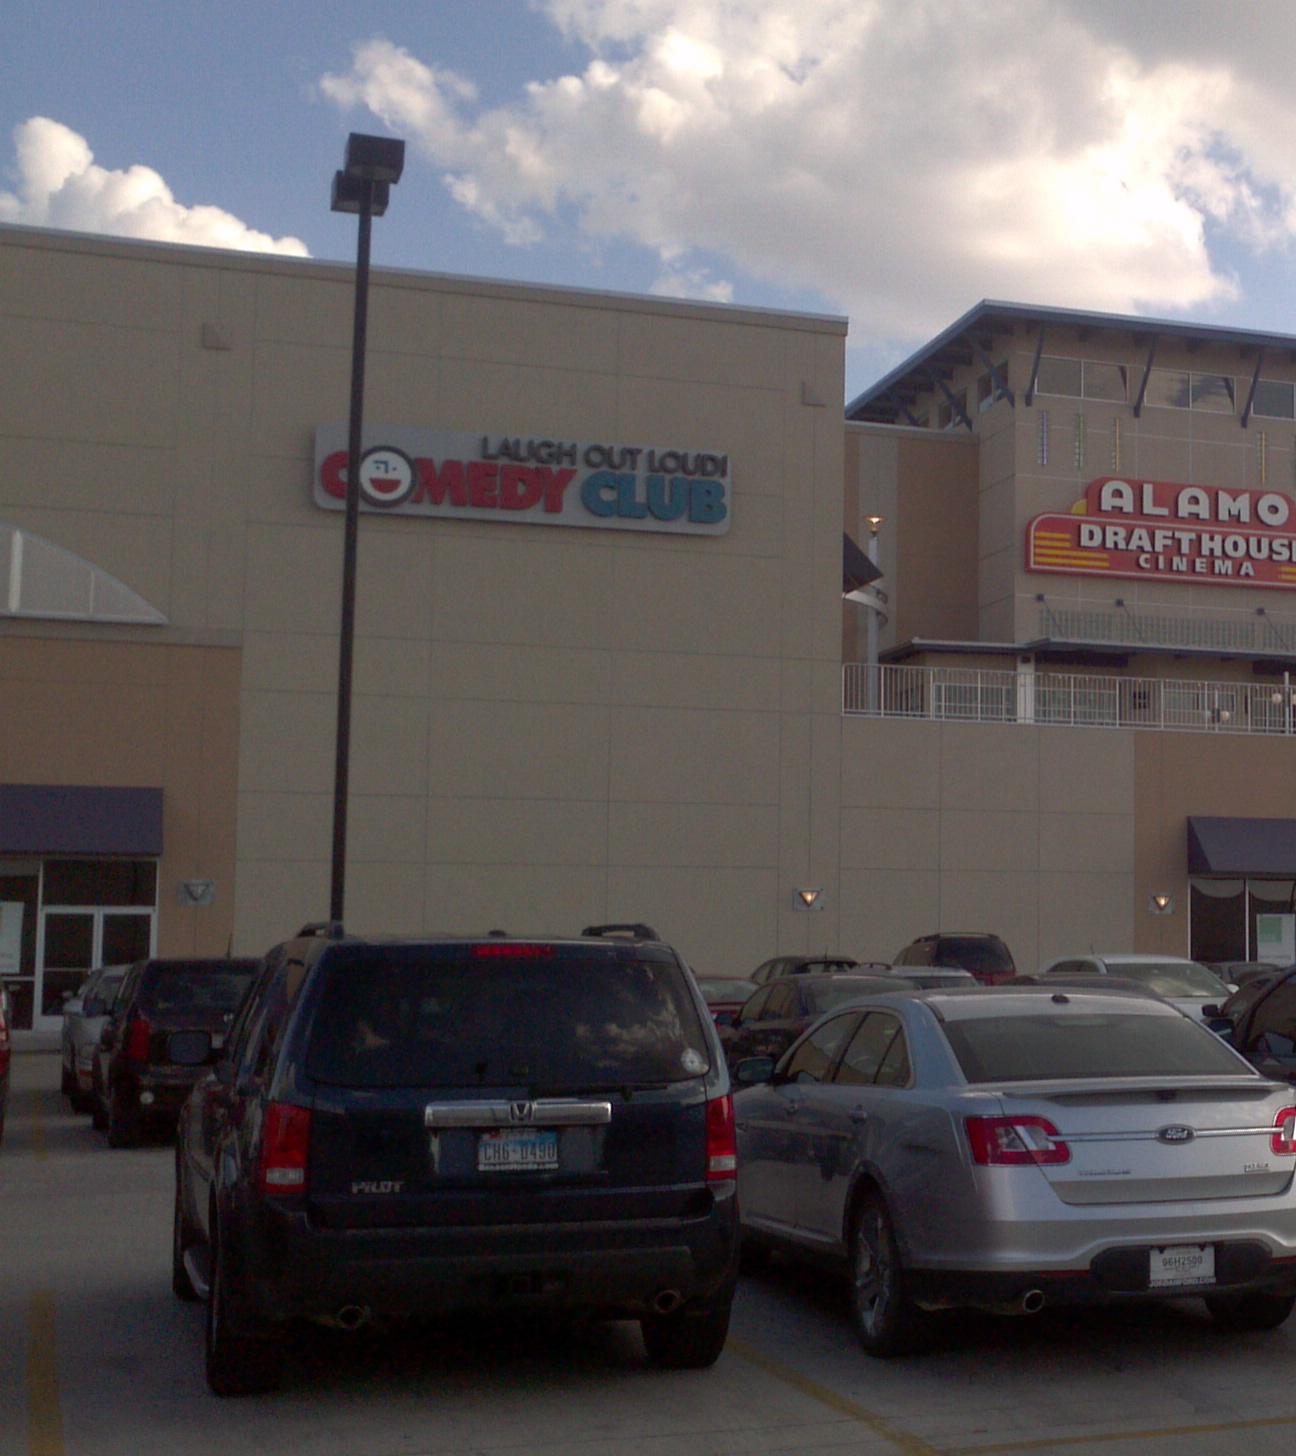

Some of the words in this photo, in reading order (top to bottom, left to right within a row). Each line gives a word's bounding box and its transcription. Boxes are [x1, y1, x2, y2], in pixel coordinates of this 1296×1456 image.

[480, 436, 577, 467] LAUGH
[583, 444, 640, 471] OUT
[581, 470, 728, 524] CLUB
[1100, 480, 1290, 527] ALAMO
[1138, 553, 1256, 577] CINEMA
[352, 1180, 404, 1194] PILOT
